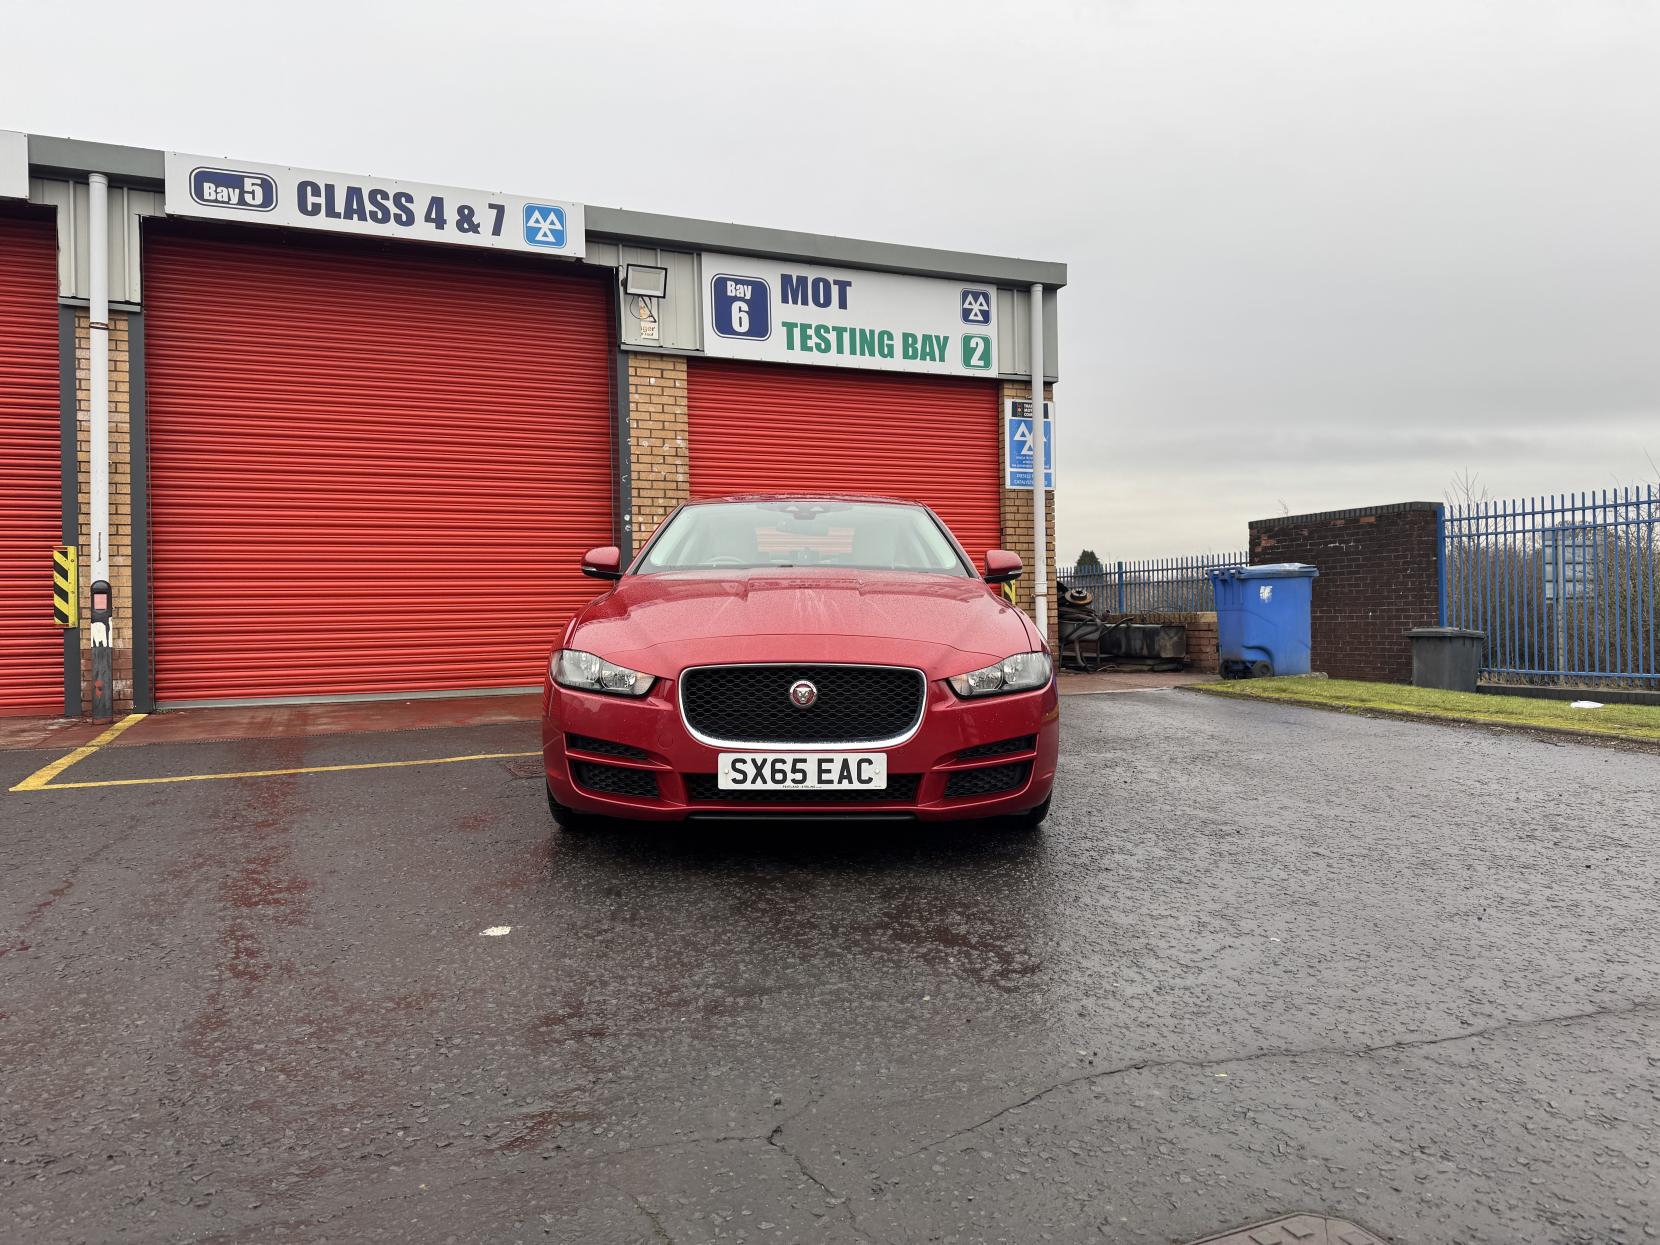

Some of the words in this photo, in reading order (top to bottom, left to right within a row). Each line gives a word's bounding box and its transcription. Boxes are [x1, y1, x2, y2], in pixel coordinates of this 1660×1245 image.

[203, 182, 240, 205] Bay
[243, 177, 264, 206] 5
[296, 180, 416, 227] CLASS
[423, 195, 447, 231] 4
[455, 204, 481, 235] &
[487, 203, 506, 237] 7
[726, 280, 752, 300] Bay
[780, 273, 853, 311] MOT
[731, 300, 750, 333] 6
[781, 321, 895, 359] TESTING
[901, 331, 950, 363] BAY
[969, 336, 985, 367] 2
[731, 758, 808, 785] SX65
[817, 758, 874, 785] EAC
